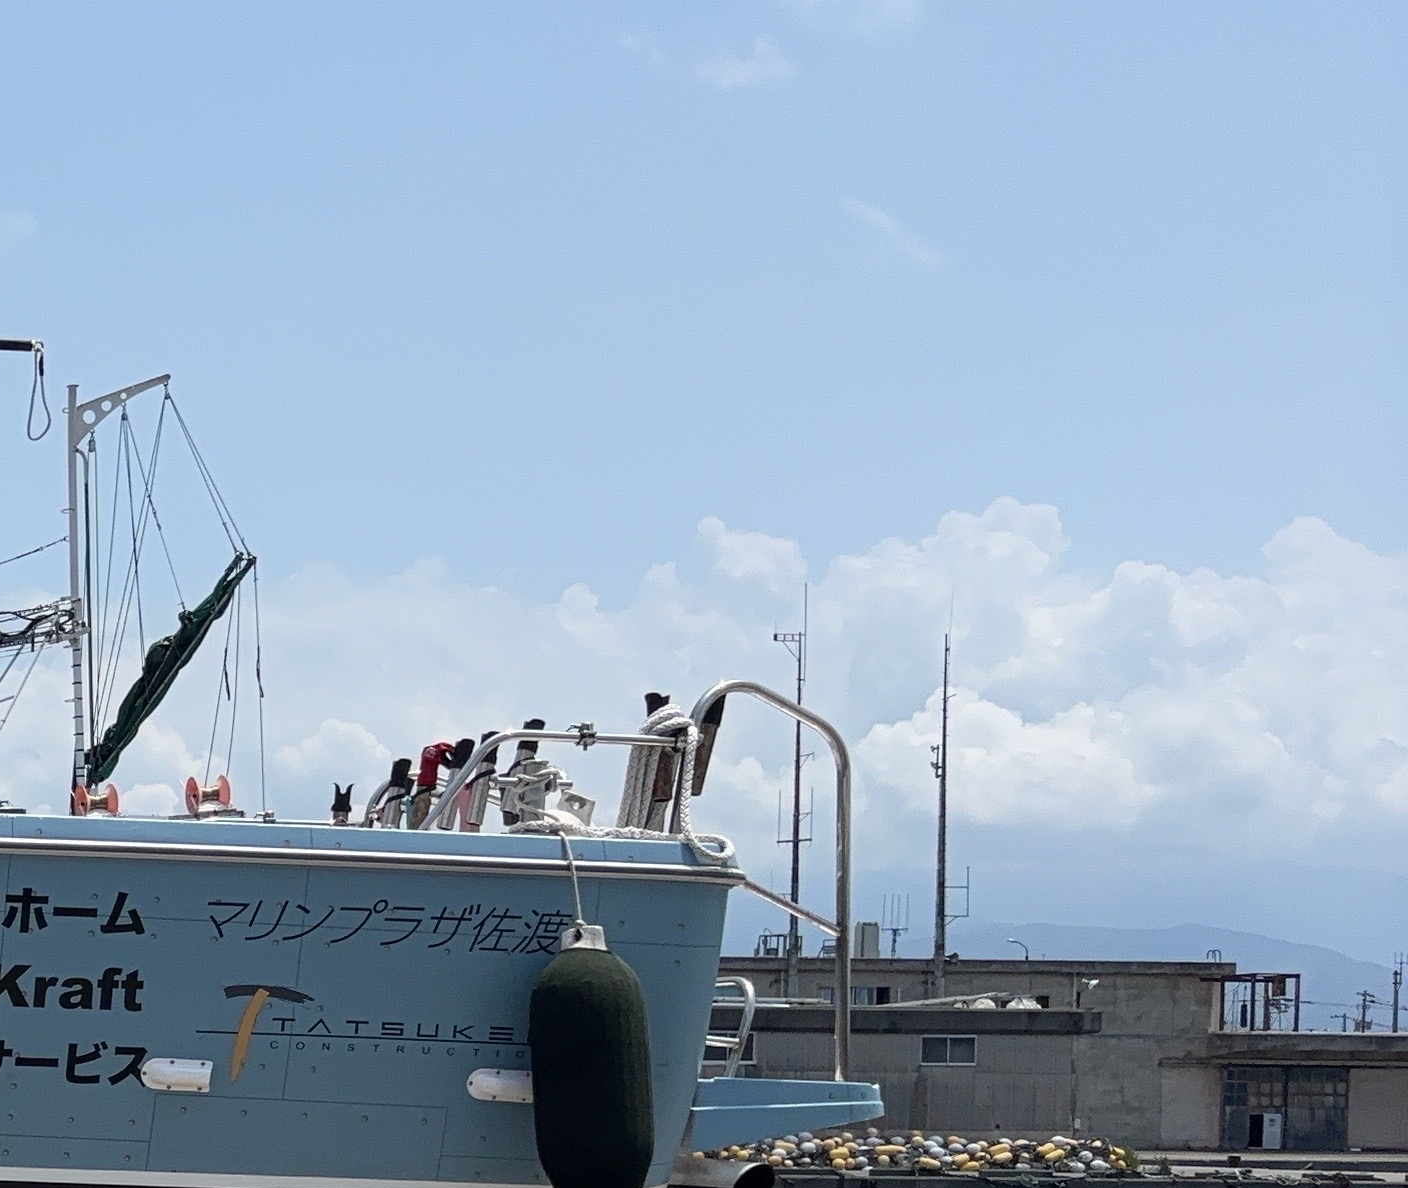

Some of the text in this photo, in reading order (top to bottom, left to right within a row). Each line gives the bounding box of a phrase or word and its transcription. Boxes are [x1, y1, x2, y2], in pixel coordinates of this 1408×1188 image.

[206, 899, 574, 956] マリンプラザ佐渡
[271, 1016, 517, 1042] TATSUKE
[269, 1040, 525, 1060] CONSTRUCTIO
